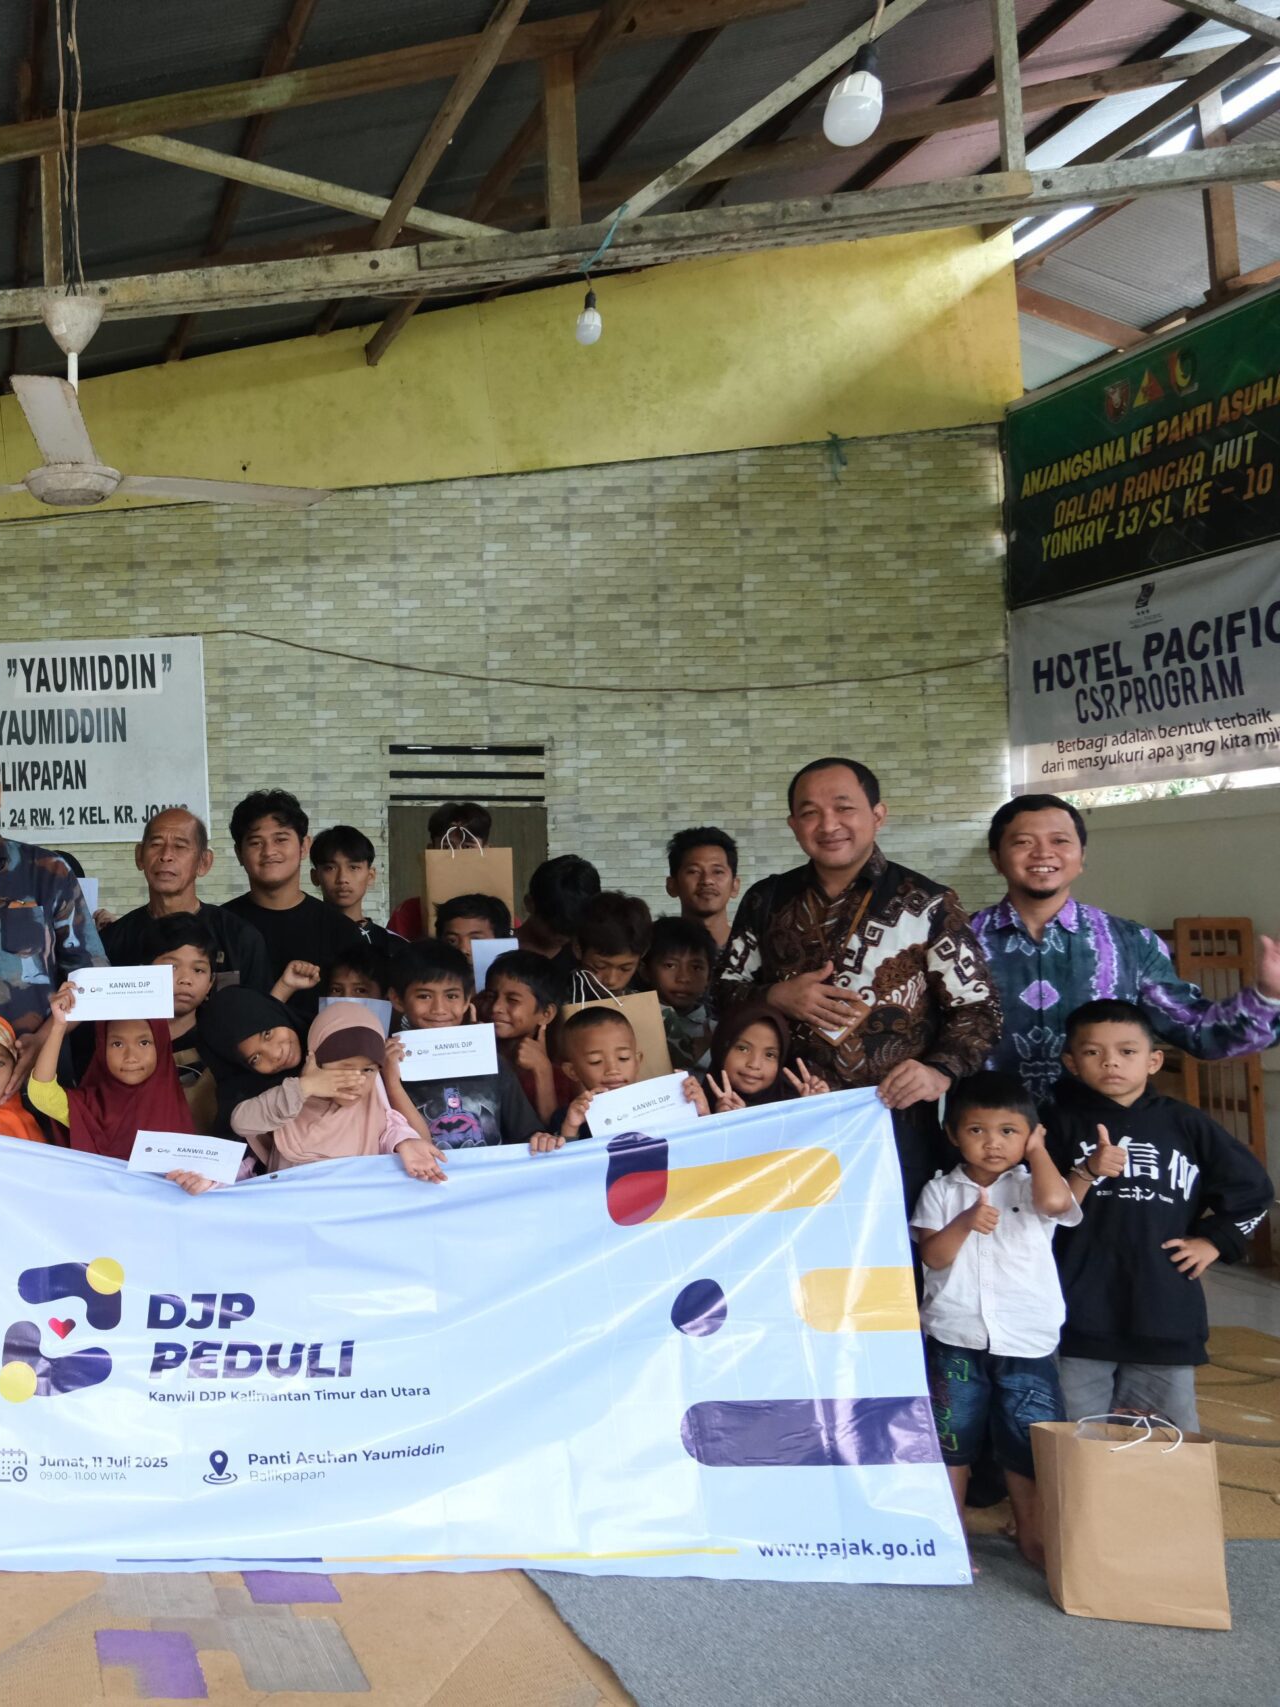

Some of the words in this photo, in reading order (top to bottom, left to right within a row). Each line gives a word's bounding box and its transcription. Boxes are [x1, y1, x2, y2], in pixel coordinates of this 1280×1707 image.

[1021, 436, 1127, 499] ANJANGSANA
[1129, 424, 1154, 458] KE
[1156, 402, 1214, 446] PANTI
[1053, 482, 1118, 529] DALAM
[1121, 450, 1206, 507] RANGKA
[1211, 430, 1258, 477] HUT
[1182, 481, 1213, 519] KE
[1243, 462, 1274, 501] 10
[1032, 641, 1133, 694] HOTEL
[1143, 601, 1280, 672] PACIFIC
[1119, 656, 1245, 716] PROGRAM
[1056, 733, 1108, 754] Berbagi
[1111, 726, 1156, 747] adalah
[1158, 717, 1213, 739] bentuk
[1215, 707, 1273, 731] terbaik
[1041, 758, 1065, 775] dari
[1067, 746, 1144, 771] mensyukuri
[1147, 746, 1174, 763] apa
[1176, 739, 1216, 761] yang
[1220, 733, 1251, 751] kita
[1, 759, 87, 793] LIKPAPAN
[9, 809, 26, 827] 24
[30, 808, 55, 827] RW.
[59, 806, 75, 826] 12
[79, 806, 110, 825] KEL.
[114, 805, 137, 824] KR.
[108, 981, 138, 989] KANWIL
[138, 980, 151, 988] DJP
[631, 1099, 657, 1112] KANWIL
[176, 1147, 204, 1155] KANWIL
[146, 1292, 256, 1330] DJP
[148, 1339, 356, 1380] PEDULI
[148, 1389, 196, 1402] Kanwil
[199, 1390, 226, 1402] DJP
[313, 1388, 356, 1401] Timur
[360, 1387, 387, 1399] dan
[390, 1385, 431, 1397] Utara
[39, 1455, 89, 1470] Jumat,
[91, 1456, 102, 1468] 11
[106, 1455, 131, 1468] Juli
[134, 1456, 168, 1469] 2025
[247, 1450, 291, 1466] Panti
[295, 1449, 358, 1465] Asuhan
[362, 1443, 445, 1462] Yaumiddin
[100, 1471, 127, 1481] WITA
[249, 1469, 326, 1484] Balikpapan
[757, 1538, 937, 1561] www.pajak.go.id
